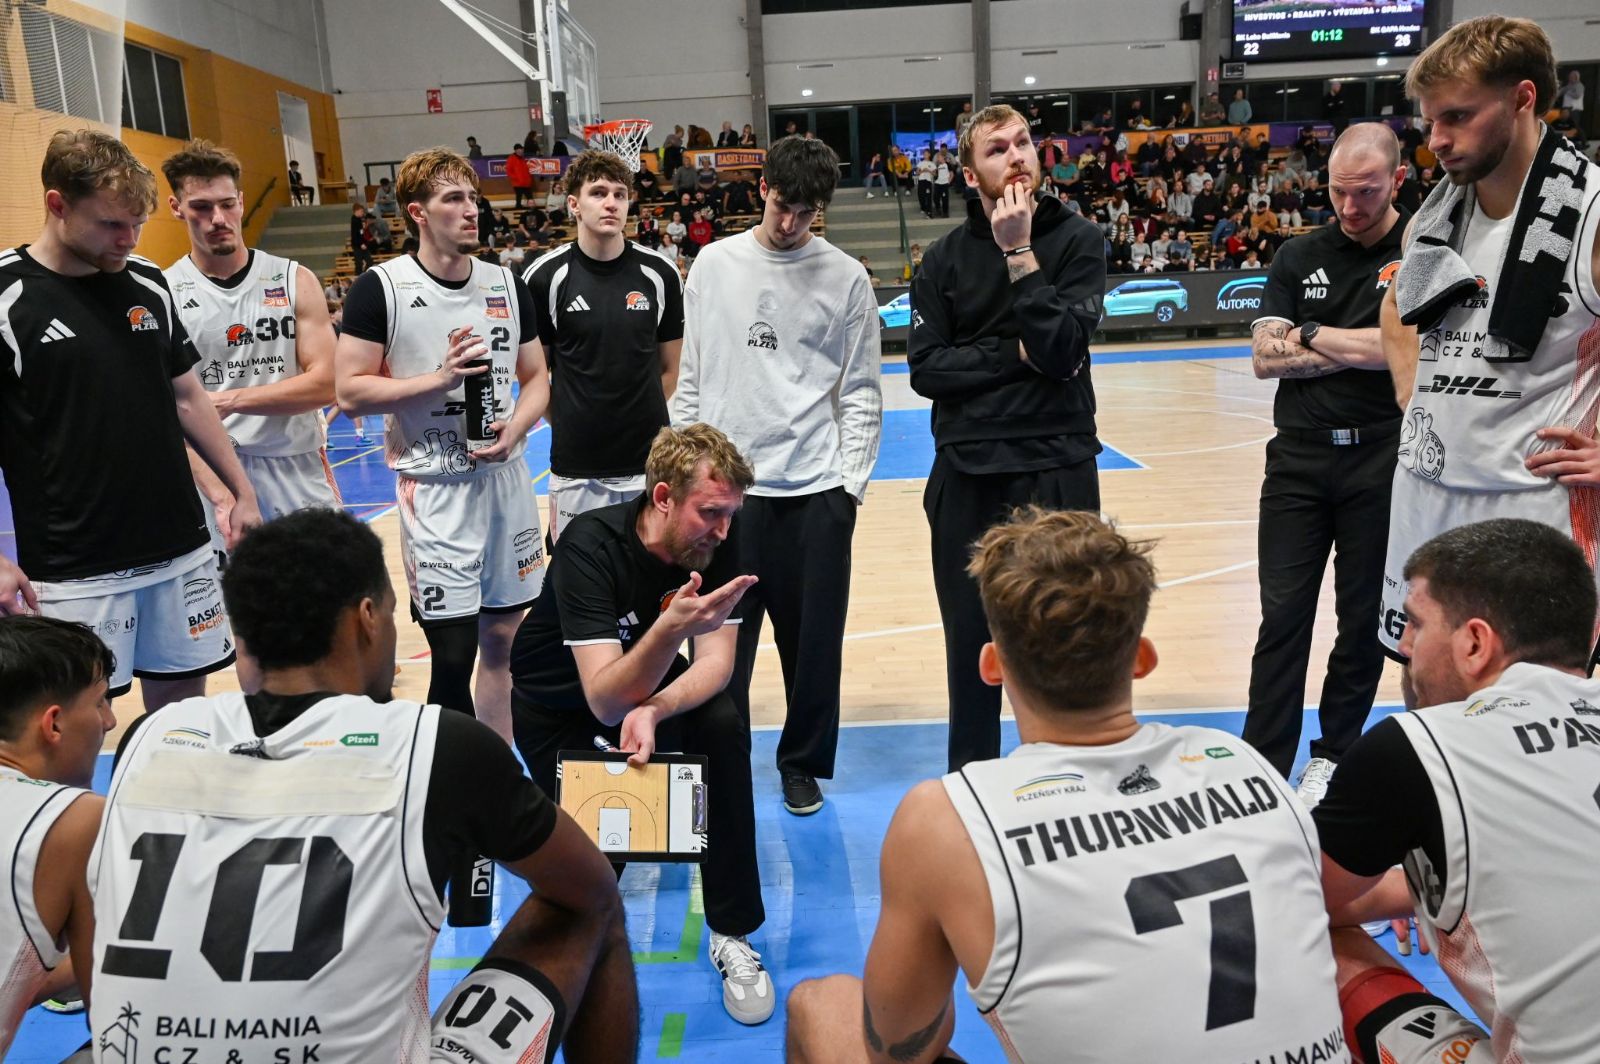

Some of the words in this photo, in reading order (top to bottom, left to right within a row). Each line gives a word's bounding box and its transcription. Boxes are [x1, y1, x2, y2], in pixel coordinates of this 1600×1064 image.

[1293, 9, 1326, 18] REALITY
[1311, 29, 1343, 41] 01:12
[1243, 42, 1259, 55] 22
[1304, 287, 1327, 299] MD
[256, 316, 296, 341] 30
[490, 326, 510, 352] 2
[1444, 331, 1471, 343] BALI
[227, 360, 250, 370] BALI
[252, 356, 284, 366] MANIA
[490, 367, 509, 375] ANIA
[1430, 374, 1502, 398] DHL
[423, 586, 447, 611] 2
[188, 601, 222, 627] BASKET
[1379, 600, 1409, 641] 6
[347, 735, 376, 744] Plzeň
[1005, 776, 1279, 866] THURNWALD
[101, 832, 354, 981] 10
[1124, 853, 1257, 1031] 7
[156, 1016, 216, 1039] BALI
[225, 1015, 322, 1039] MANIA
[445, 984, 534, 1050] 10
